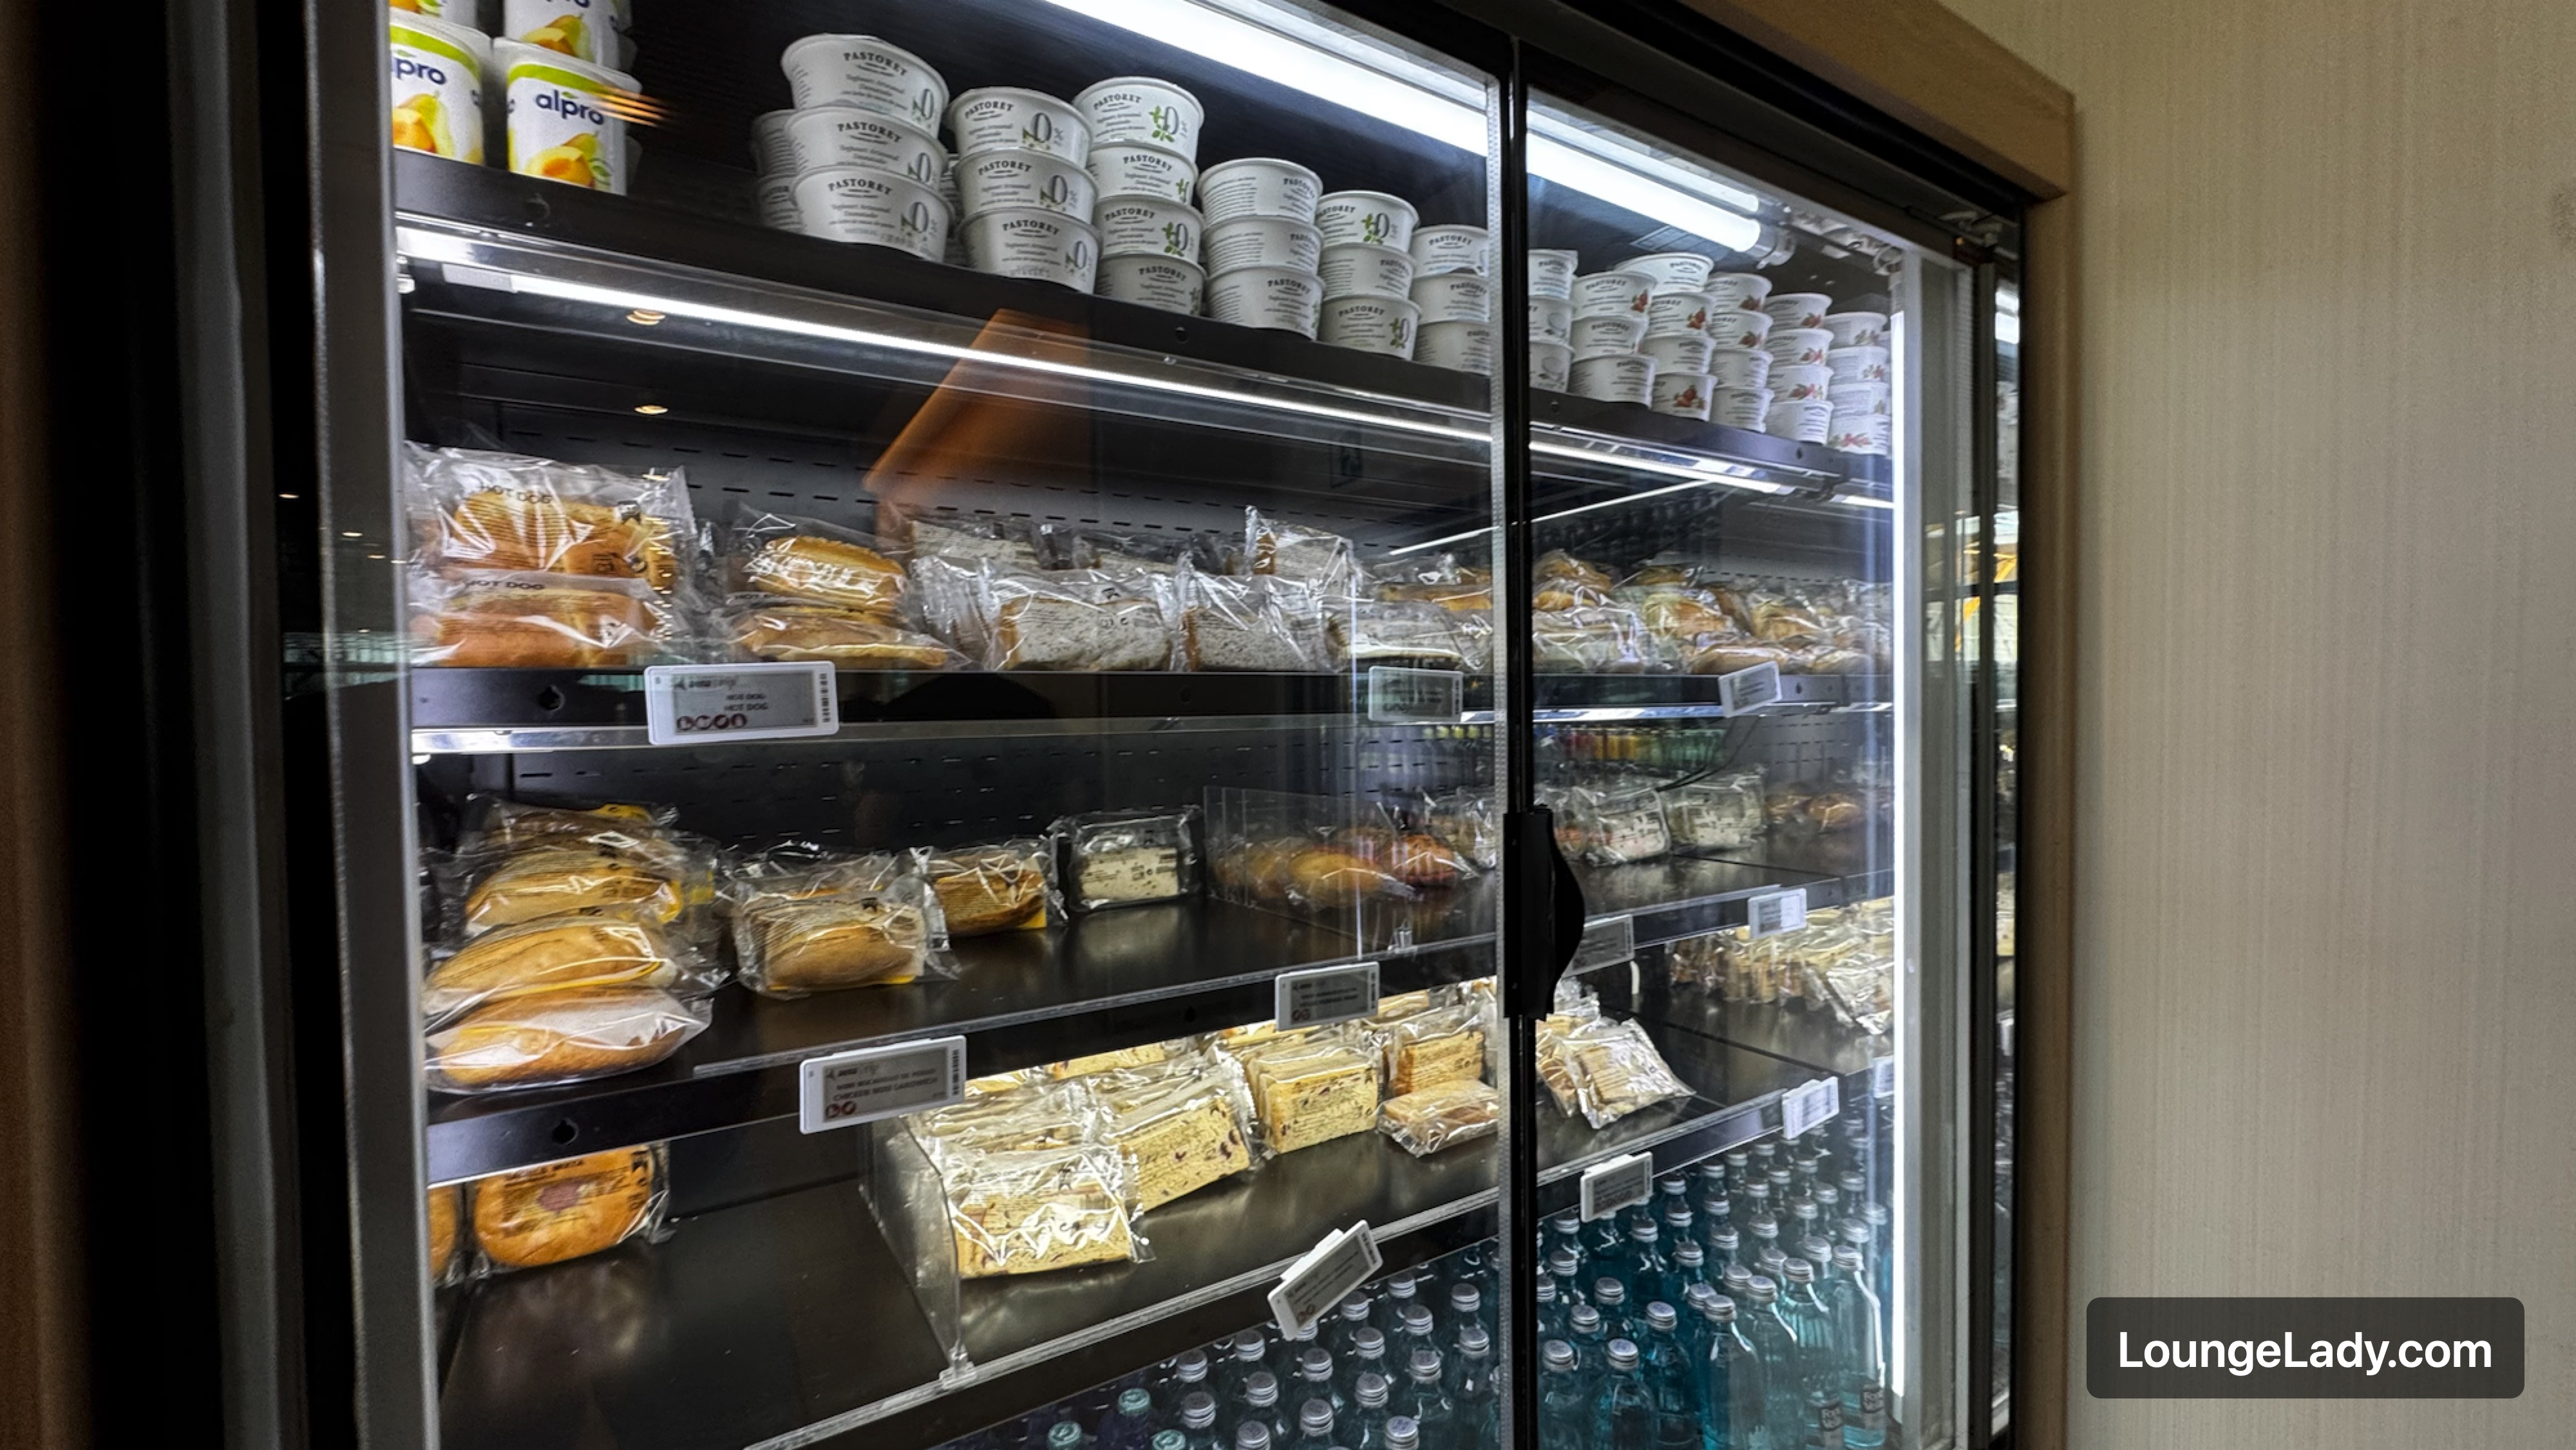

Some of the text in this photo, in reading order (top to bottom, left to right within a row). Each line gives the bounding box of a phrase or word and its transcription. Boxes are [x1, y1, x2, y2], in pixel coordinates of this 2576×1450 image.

[391, 55, 447, 86] pro
[843, 52, 908, 75] PASTORET
[535, 89, 604, 125] alpro
[965, 101, 1014, 119] PASTORET
[837, 122, 902, 142] PASTORET
[978, 160, 1032, 176] PASTORET
[828, 178, 893, 195] PASTORET
[1002, 220, 1061, 236] PASTORET
[505, 581, 546, 590] DOG
[746, 702, 769, 711] DOG
